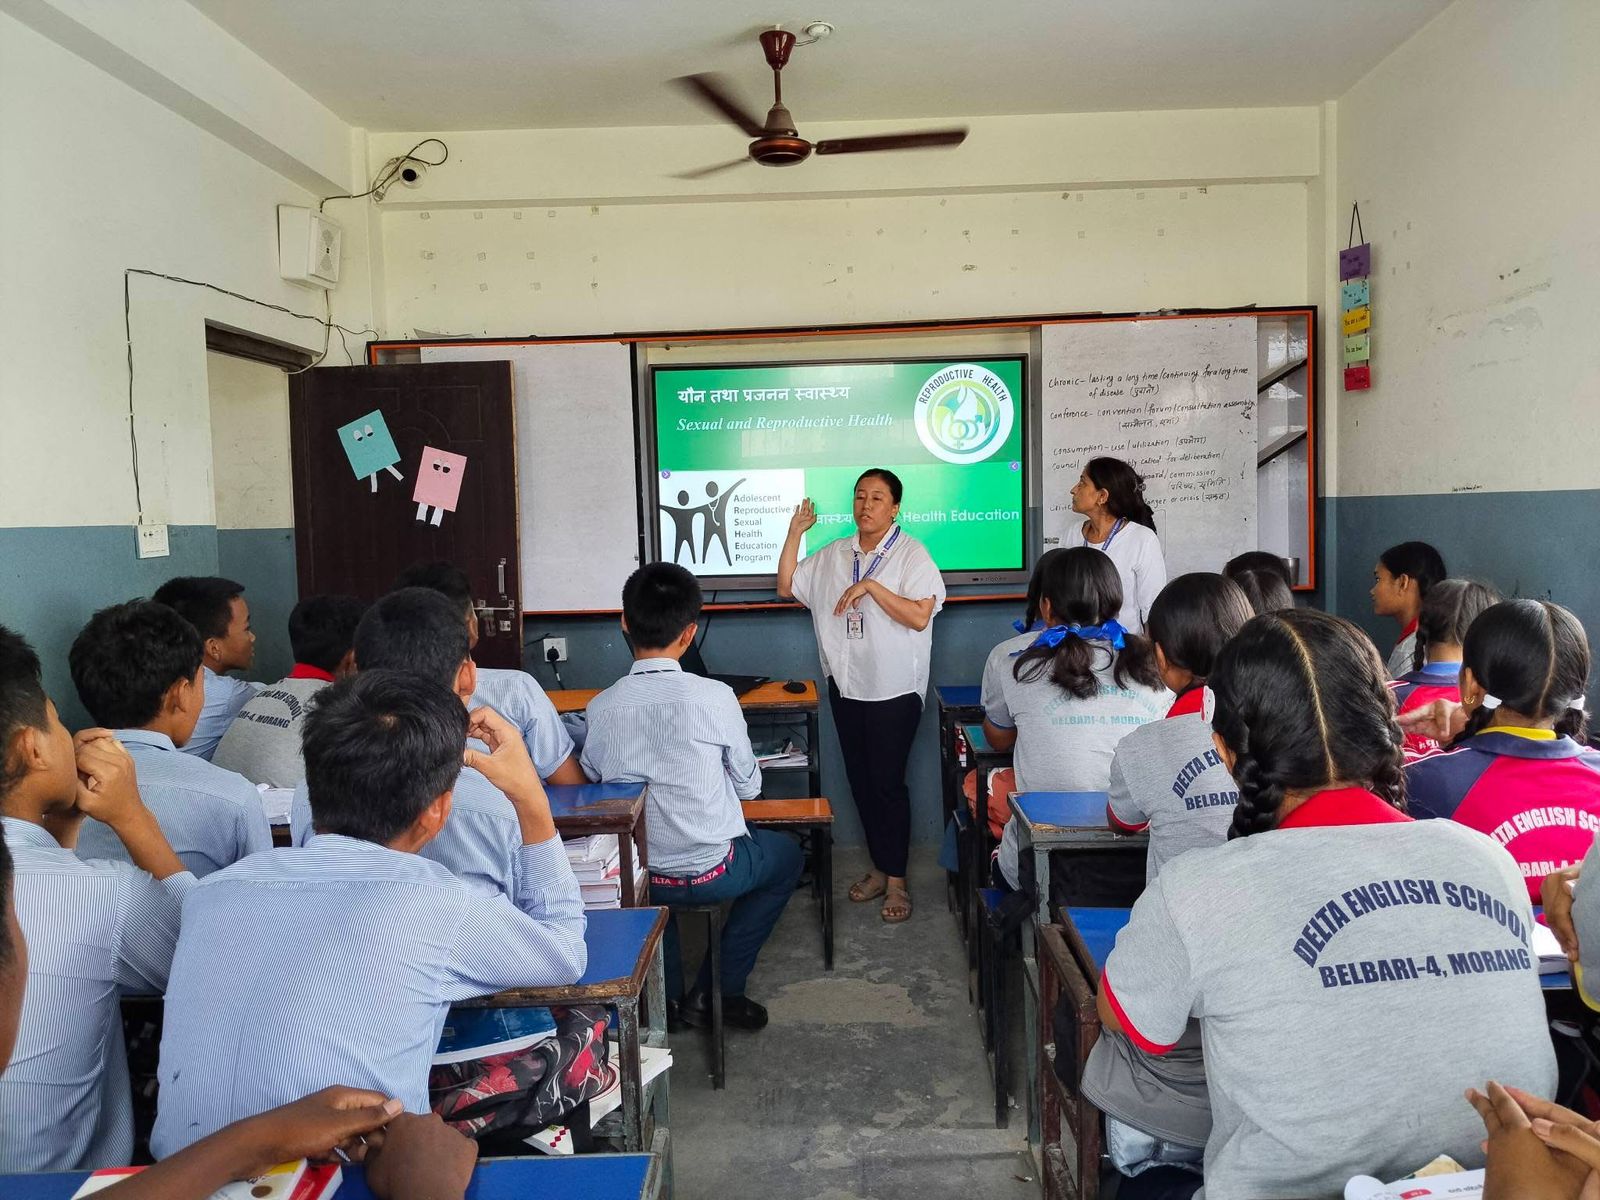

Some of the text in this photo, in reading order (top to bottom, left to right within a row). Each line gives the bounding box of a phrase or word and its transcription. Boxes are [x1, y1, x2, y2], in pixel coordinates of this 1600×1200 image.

[918, 368, 1008, 405] REPRODUCTIVE HEALTH
[677, 386, 851, 404] यौन तथा प्रजनन स्वास्थ्य
[677, 413, 893, 431] Sexual and Reproductive Health
[733, 494, 781, 502] Adolescent
[734, 506, 791, 515] Reproductive
[903, 509, 1020, 523] Health Education
[734, 518, 762, 526] Sexual
[816, 514, 853, 524] वास्थ्य
[734, 530, 763, 538] Health
[735, 542, 778, 550] Education
[735, 553, 772, 563] Program
[255, 715, 290, 728] MORANG
[1172, 757, 1207, 799] DELTA
[1184, 791, 1240, 811] BELBAR
[1490, 820, 1519, 847] LTA
[1512, 806, 1577, 834] ENGLISH
[651, 870, 719, 886] ELTA DELTA
[1293, 879, 1529, 968] DELTA ENGLISH SCHOOL
[1318, 948, 1532, 988] BELBARI-4, MORANG
